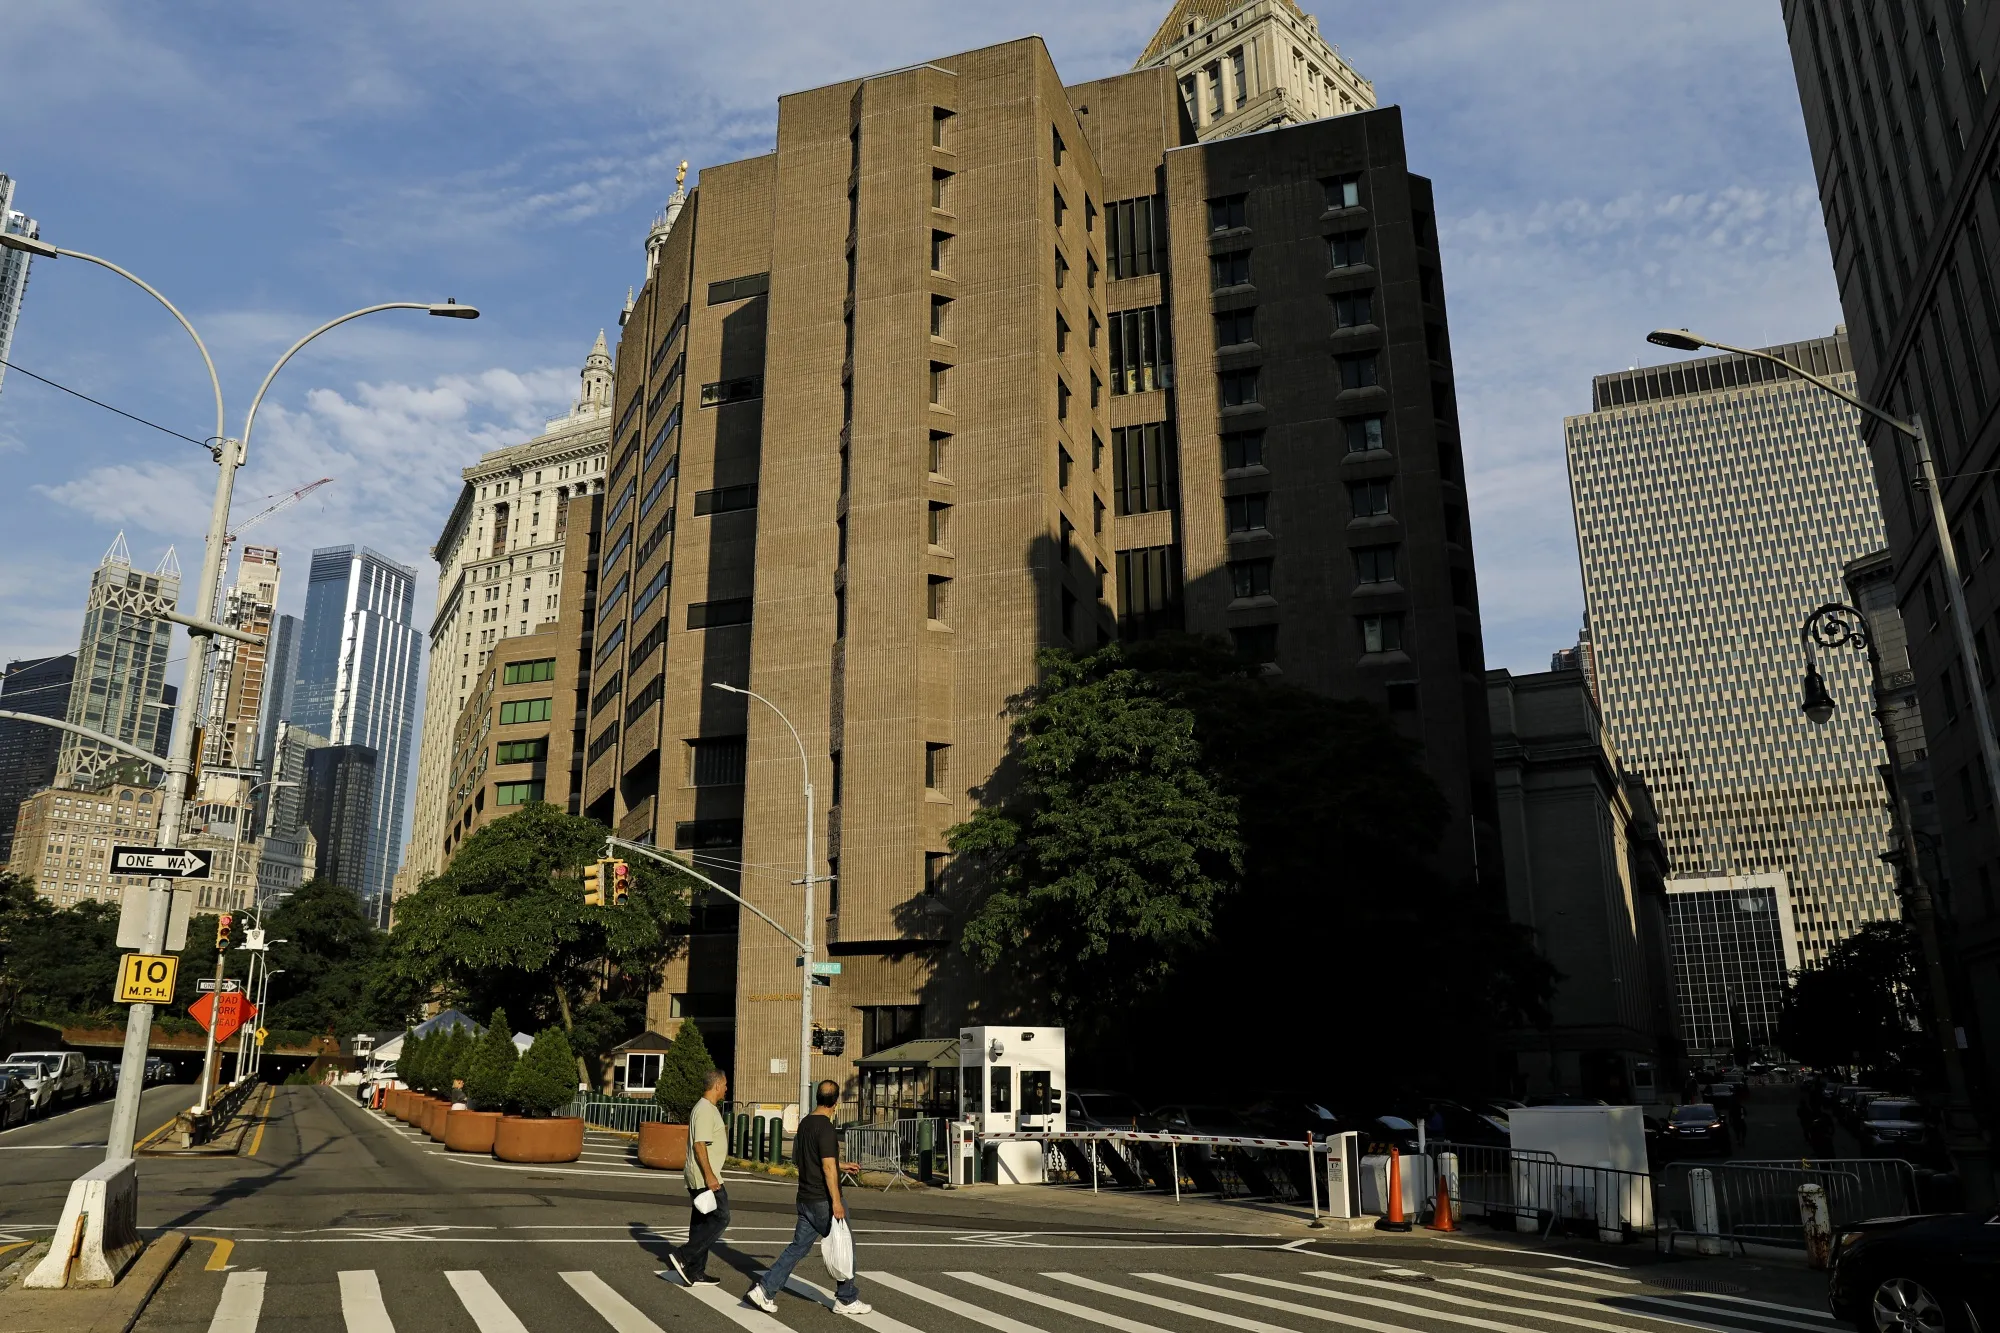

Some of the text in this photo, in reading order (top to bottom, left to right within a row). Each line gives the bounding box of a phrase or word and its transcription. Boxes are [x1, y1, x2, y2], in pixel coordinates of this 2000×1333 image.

[126, 855, 197, 869] ONE WAY
[134, 959, 168, 984] 10
[815, 964, 832, 973] PEARL
[219, 996, 238, 1004] OAD
[784, 993, 802, 1001] ROW
[218, 1007, 236, 1015] ORK
